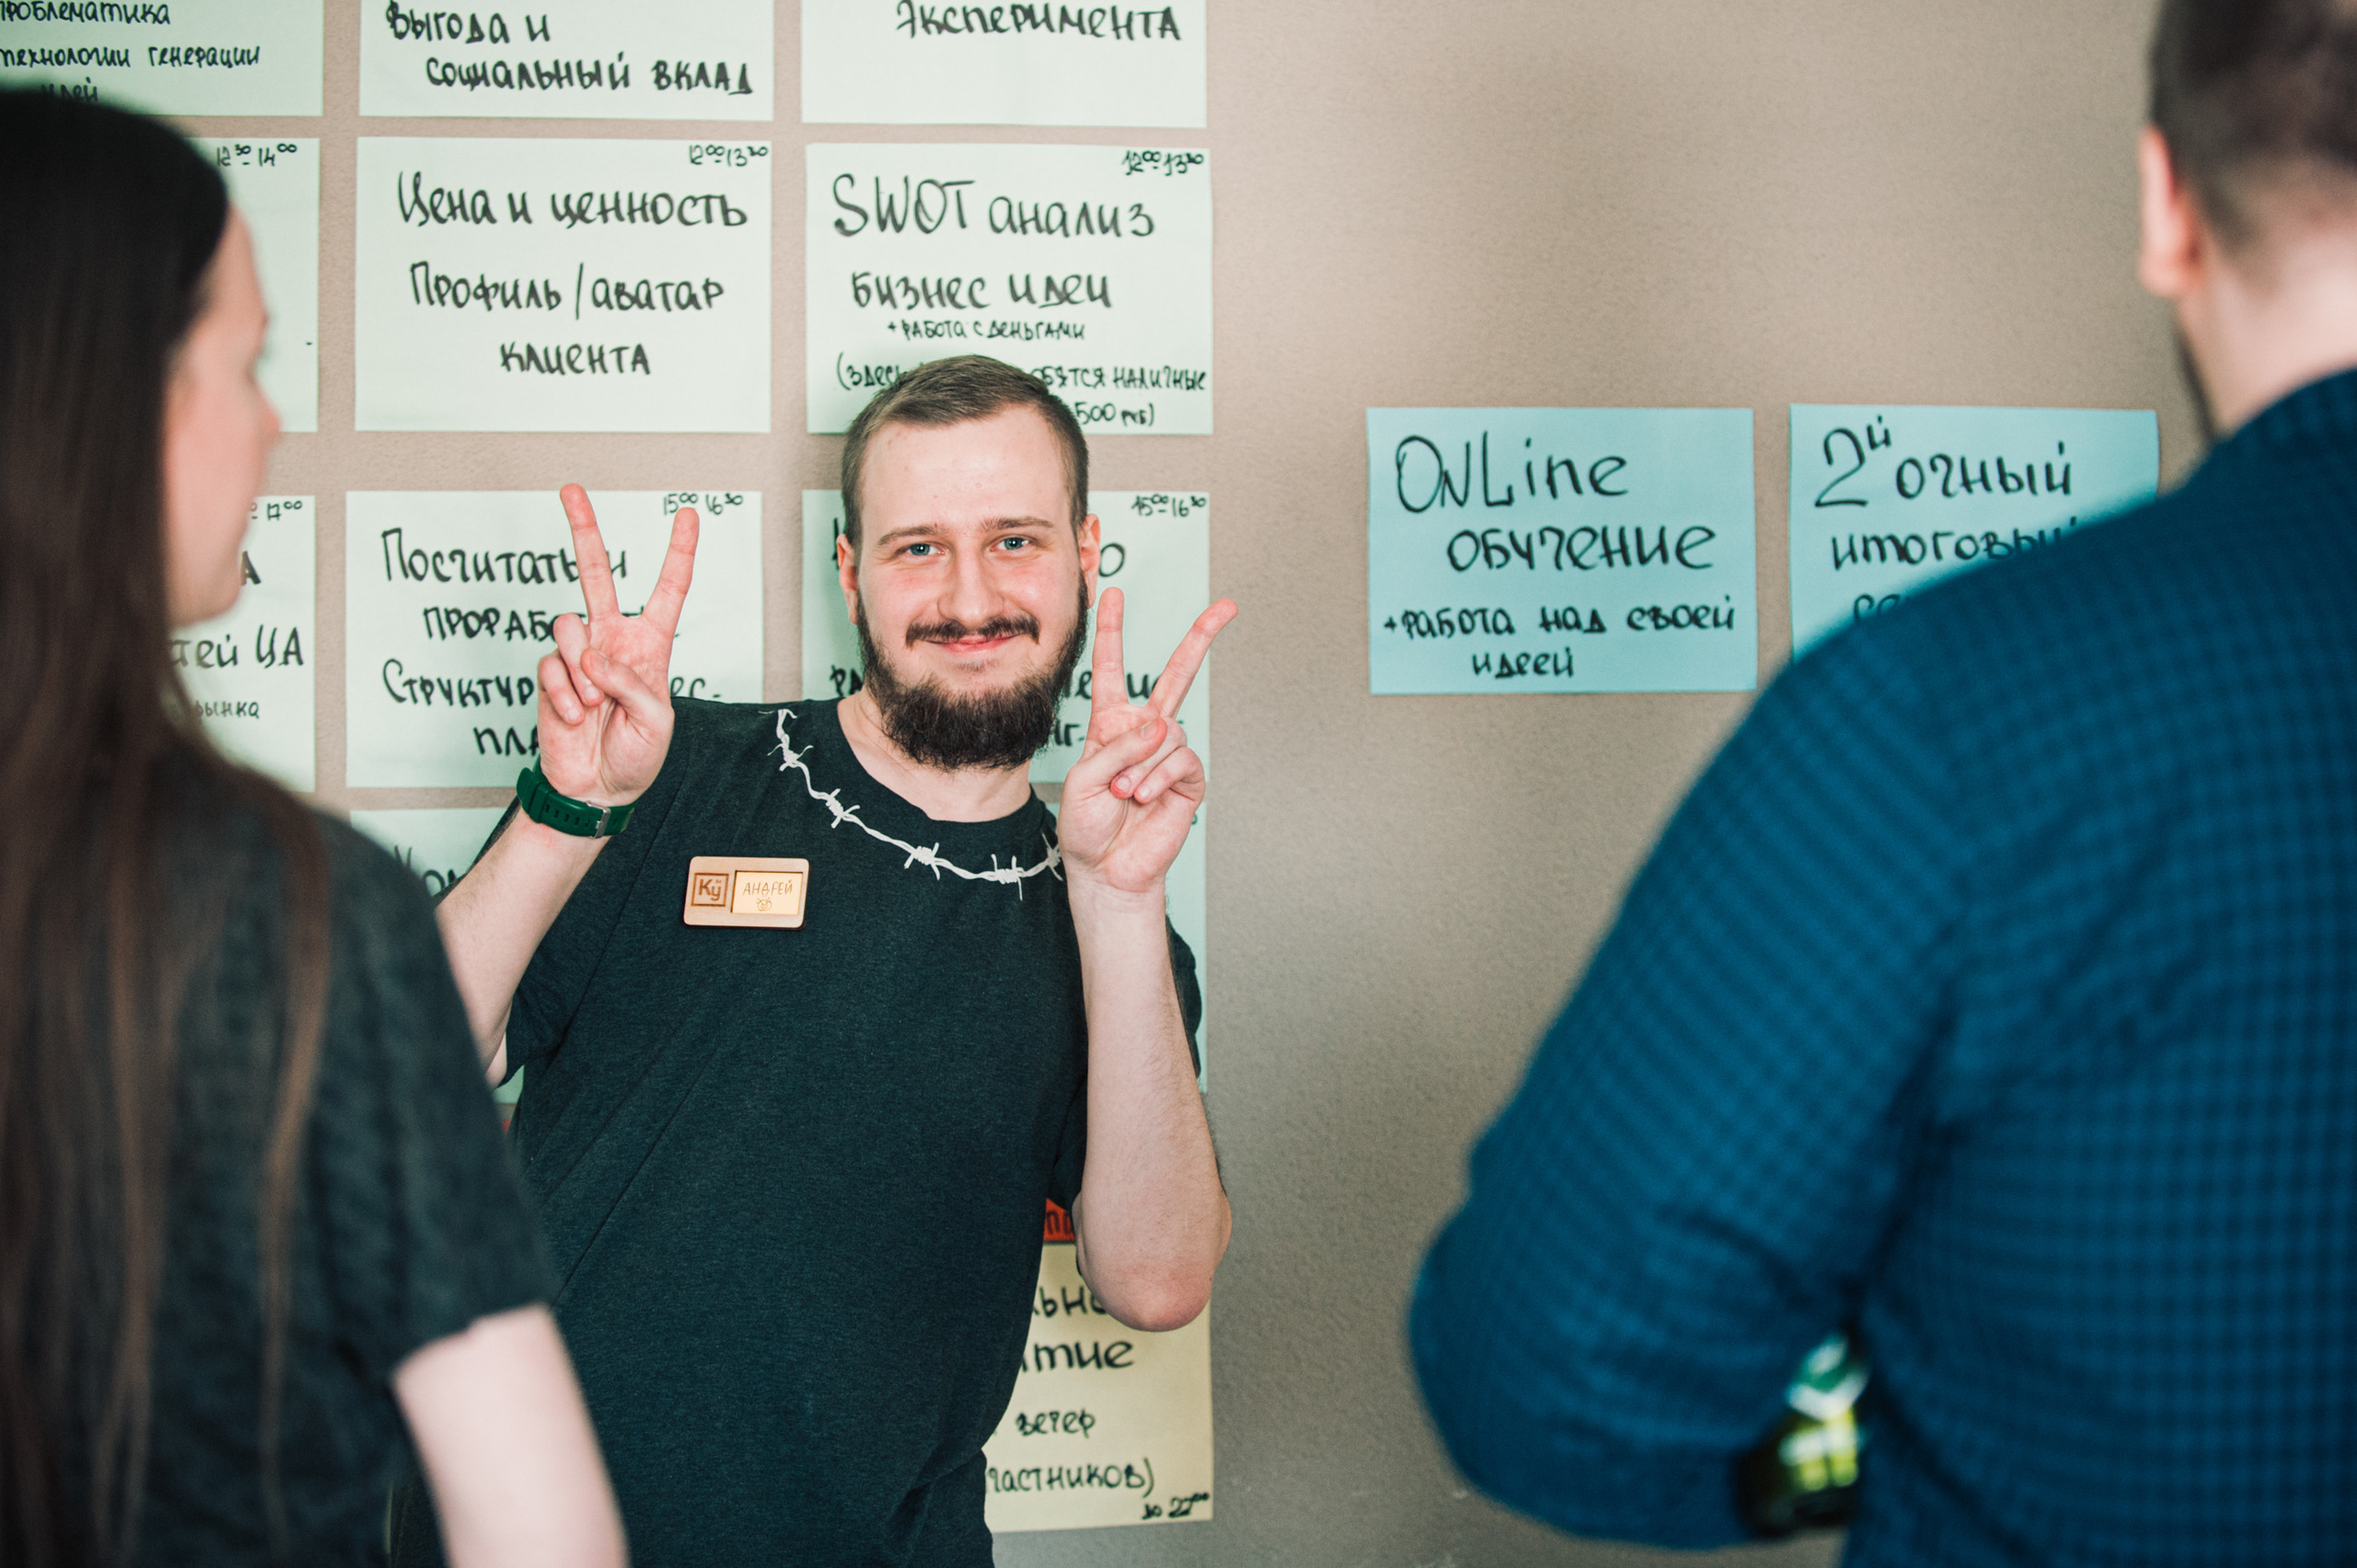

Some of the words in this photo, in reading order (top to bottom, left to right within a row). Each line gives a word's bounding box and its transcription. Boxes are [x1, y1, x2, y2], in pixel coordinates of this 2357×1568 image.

[385, 0, 510, 45] Выгода
[525, 14, 551, 42] и
[896, 0, 1181, 41] эксперимента
[147, 45, 261, 69] генерации
[425, 51, 630, 92] социальный
[650, 59, 753, 96] вклад
[397, 170, 497, 227] Цена
[506, 192, 533, 225] и
[550, 191, 748, 229] ценность
[832, 172, 975, 238] SWOT
[988, 195, 1155, 238] анализ
[851, 271, 990, 311] бизнес
[1008, 273, 1112, 309] идеи
[499, 341, 651, 376] клиента
[1895, 440, 2072, 501] очный
[380, 526, 580, 585] Посчитать
[1446, 524, 1717, 574] обучение
[1538, 605, 1608, 634] над
[1625, 594, 1736, 633] своей
[255, 624, 304, 669] ЦА
[1471, 645, 1575, 680] идеей
[382, 657, 535, 708] Структур
[987, 1457, 1155, 1499] частников)
